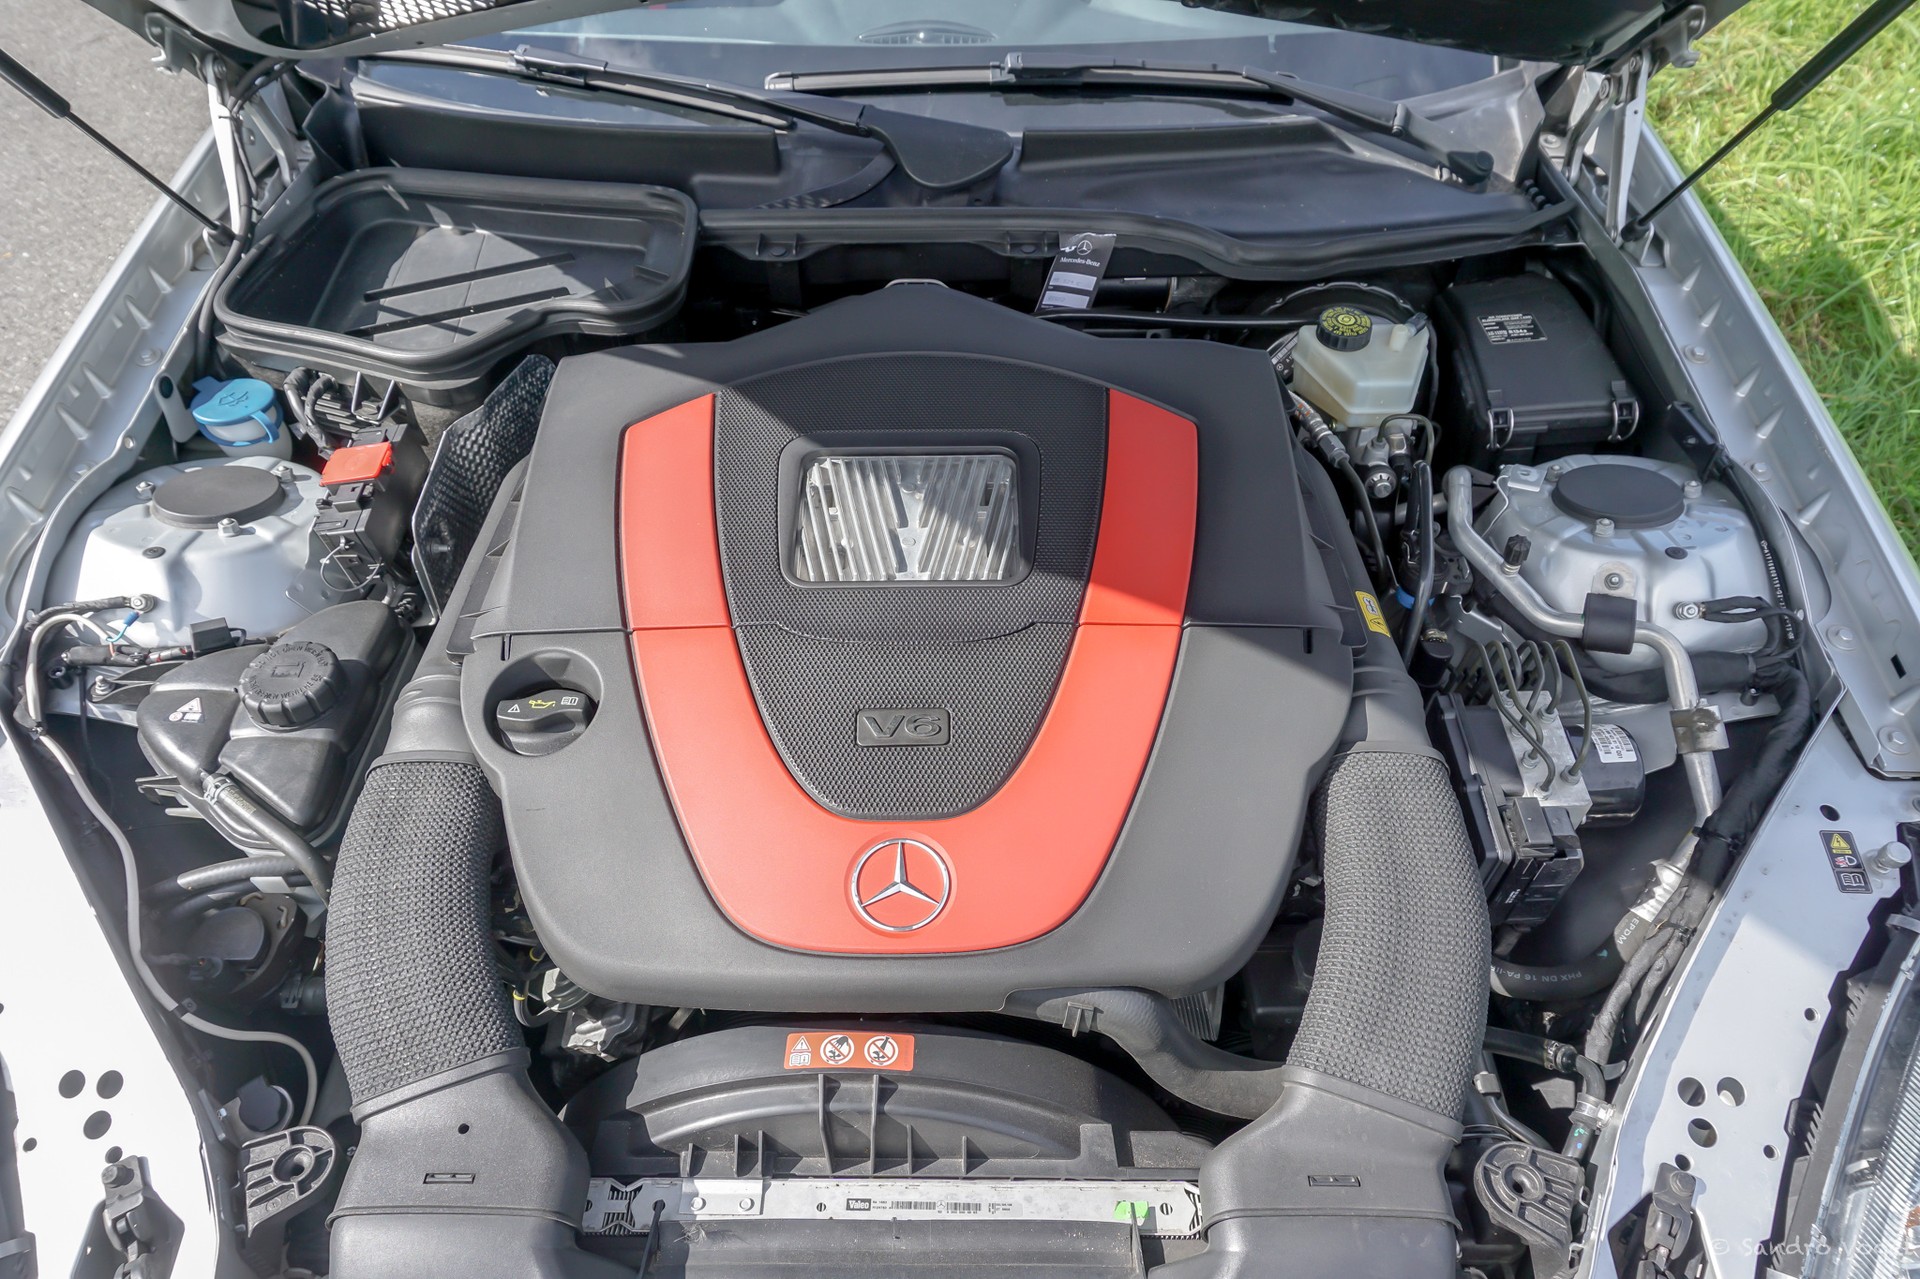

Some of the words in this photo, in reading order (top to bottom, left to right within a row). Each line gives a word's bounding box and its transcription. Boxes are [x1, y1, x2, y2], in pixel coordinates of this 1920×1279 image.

[1060, 257, 1100, 267] Mercedes-Benz
[863, 715, 942, 738] V6
[1524, 973, 1537, 981] 16
[1559, 971, 1583, 981] PHX
[848, 1200, 870, 1210] Valeo
